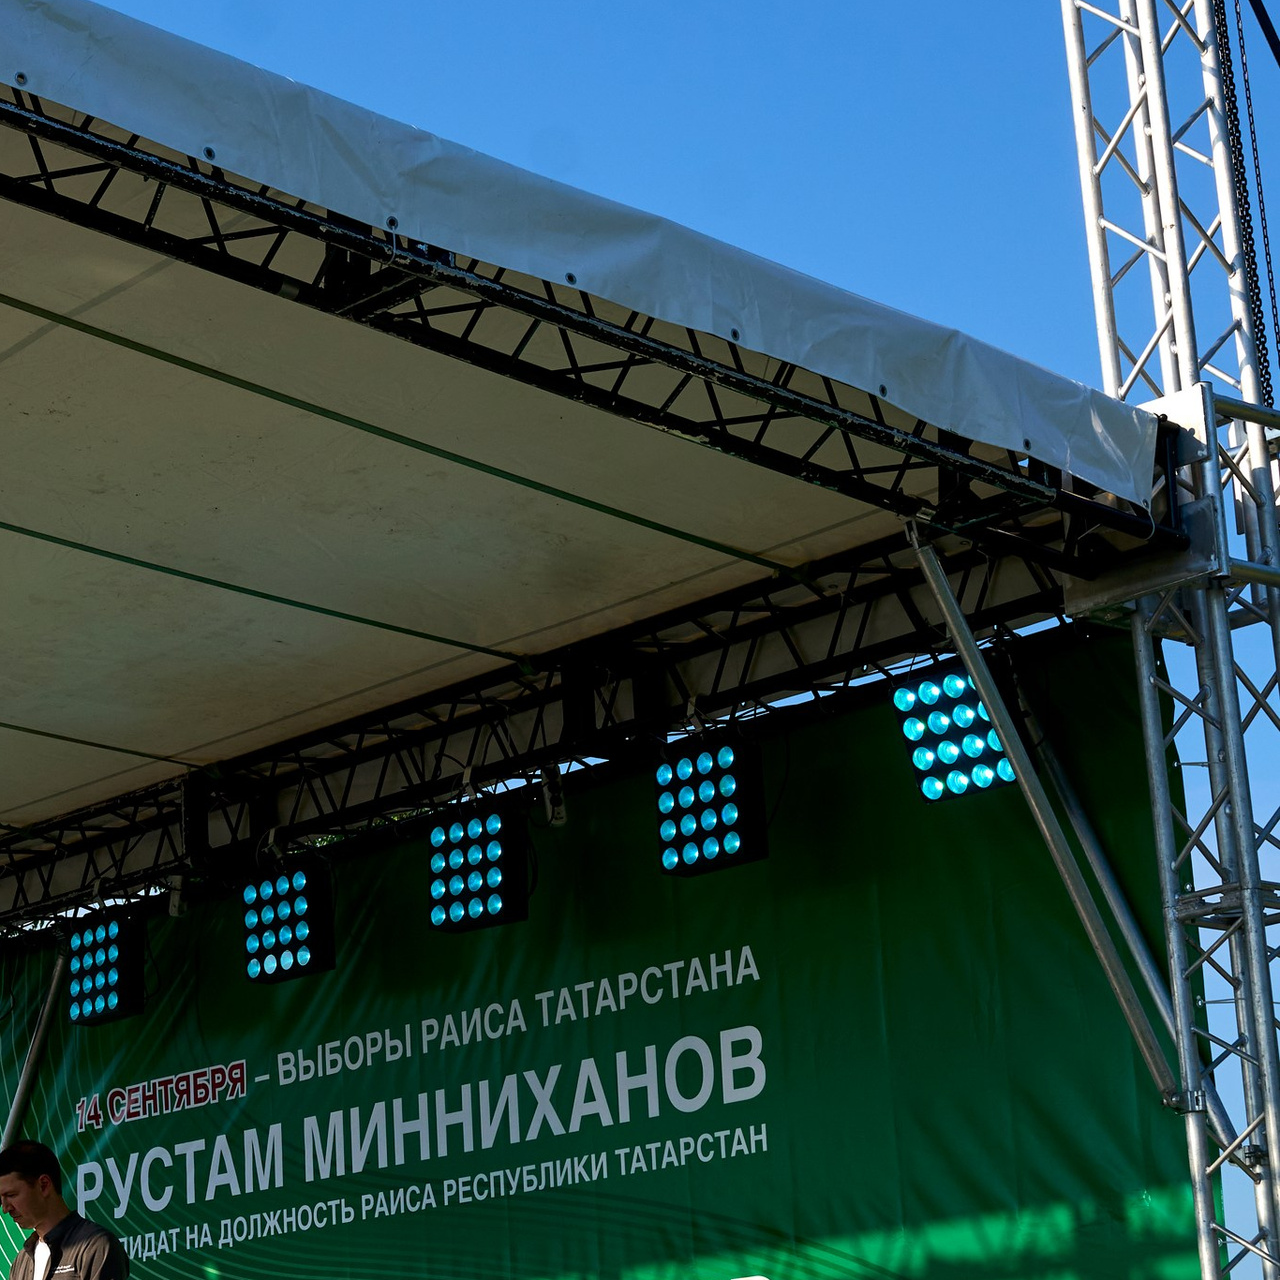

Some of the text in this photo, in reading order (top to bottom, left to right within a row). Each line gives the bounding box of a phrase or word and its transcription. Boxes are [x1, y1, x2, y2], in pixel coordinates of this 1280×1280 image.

[76, 1093, 102, 1132] 14
[107, 1059, 247, 1125] СЕНТЯБРЯ
[277, 1024, 412, 1086] ВЫБОРЫ
[421, 998, 527, 1054] РАИСА
[535, 945, 760, 1027] ТАТАРСТАНА
[76, 1025, 767, 1219] РУСТАМ МИННИХАНОВ
[119, 1123, 768, 1262] ИДАТ НА ДОЛЖНОСТЬ РАИСА РЕСПУБЛИКИ ТАТАРСТАН
